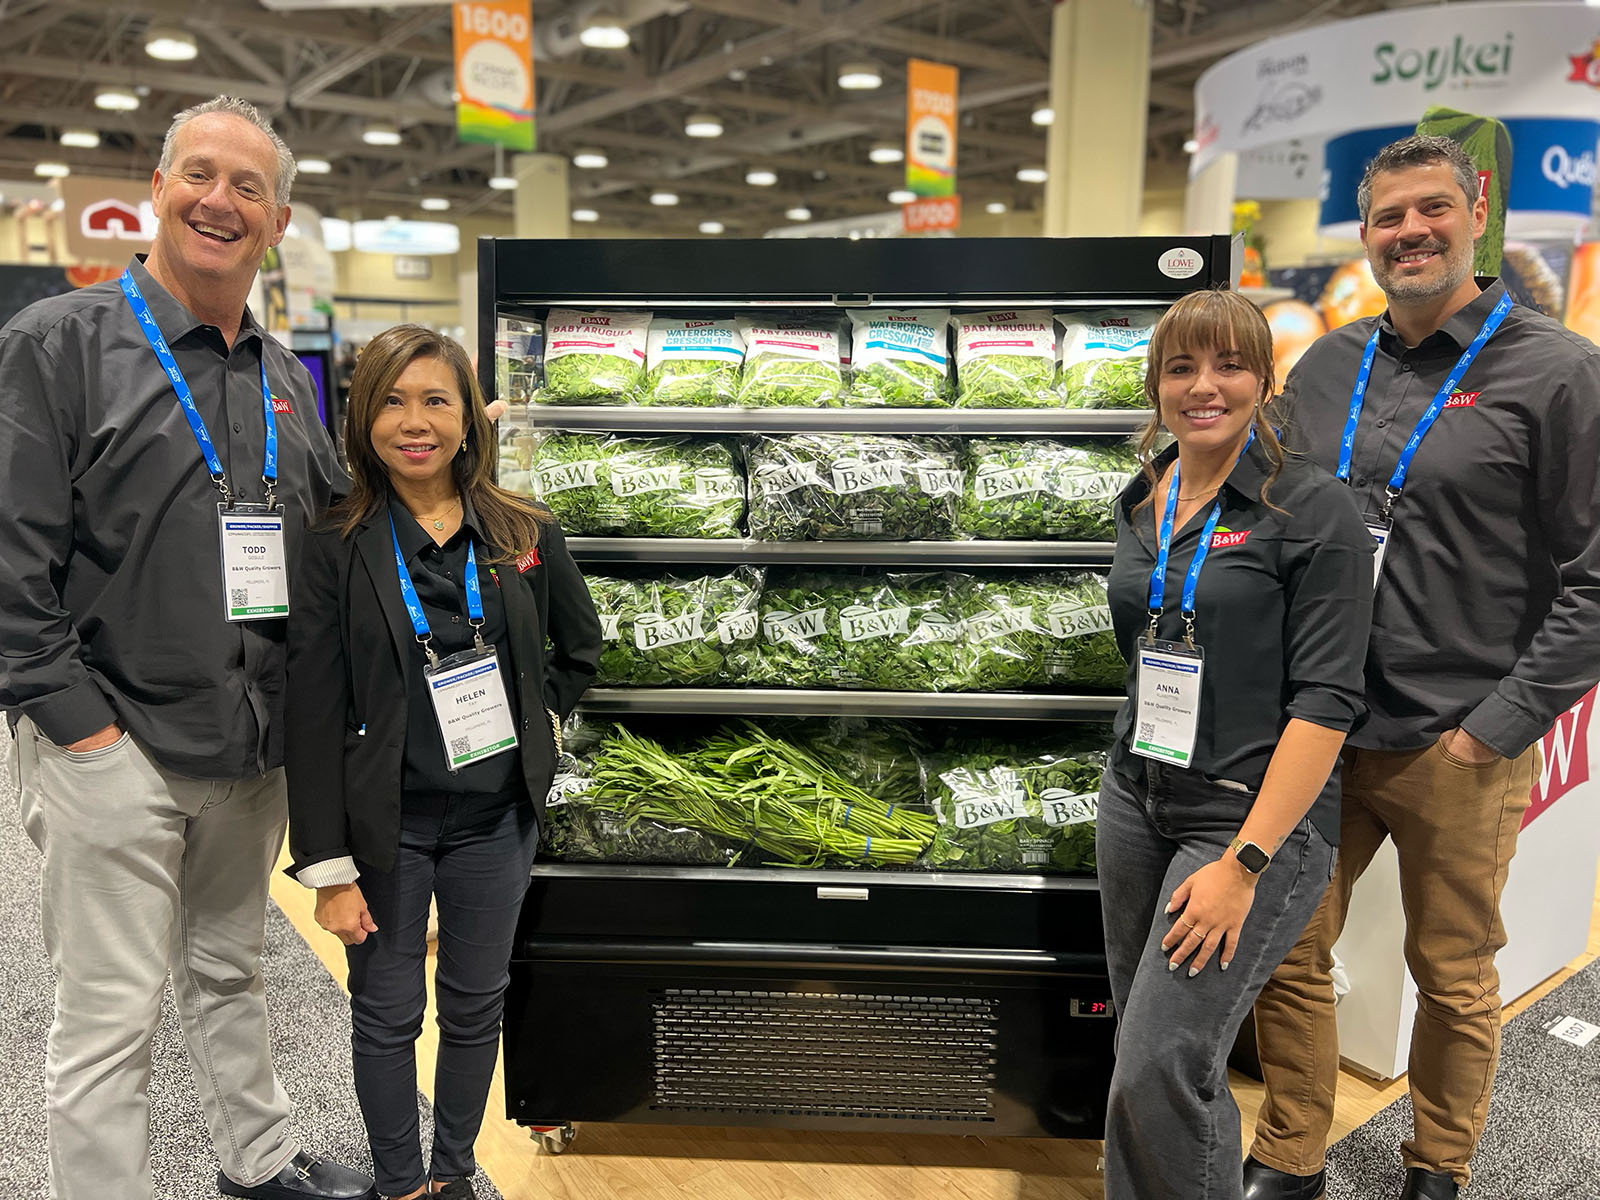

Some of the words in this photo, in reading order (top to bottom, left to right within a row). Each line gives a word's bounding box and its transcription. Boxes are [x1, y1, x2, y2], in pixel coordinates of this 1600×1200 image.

[459, 4, 529, 43] 1600
[1371, 31, 1515, 92] Soykei
[913, 88, 953, 116] 1700
[1167, 258, 1195, 268] LOWE
[553, 325, 582, 333] BABY
[584, 326, 633, 337] ARUGULA
[666, 328, 733, 338] WATERCRESS
[783, 330, 833, 339] ARUGULA
[868, 328, 914, 345] CRESSON
[869, 320, 936, 338] WATERCRESS
[963, 324, 992, 333] BABY
[995, 323, 1046, 332] ARUGULA
[665, 337, 712, 345] CRESSON
[271, 400, 290, 412] B&W
[1442, 393, 1475, 407] B&W
[540, 464, 589, 494] B&W
[621, 471, 672, 495] B&W
[768, 463, 810, 493] B&W
[841, 464, 894, 491] B&W
[982, 469, 1036, 498] B&W
[1067, 474, 1122, 498] B&W
[242, 546, 267, 554] TODD
[1211, 532, 1245, 547] B&W
[643, 616, 696, 647] B&W
[768, 613, 818, 643] B&W
[848, 612, 901, 638] B&W
[974, 611, 1025, 640] B&W
[1057, 608, 1111, 635] B&W
[455, 689, 486, 704] HELEN
[1156, 684, 1180, 695] ANNA
[447, 716, 461, 725] B&W
[461, 711, 481, 721] Quality
[480, 703, 503, 713] Growers
[961, 796, 1015, 825] B&W
[1050, 797, 1098, 824] B&W
[1091, 1002, 1105, 1012] 37
